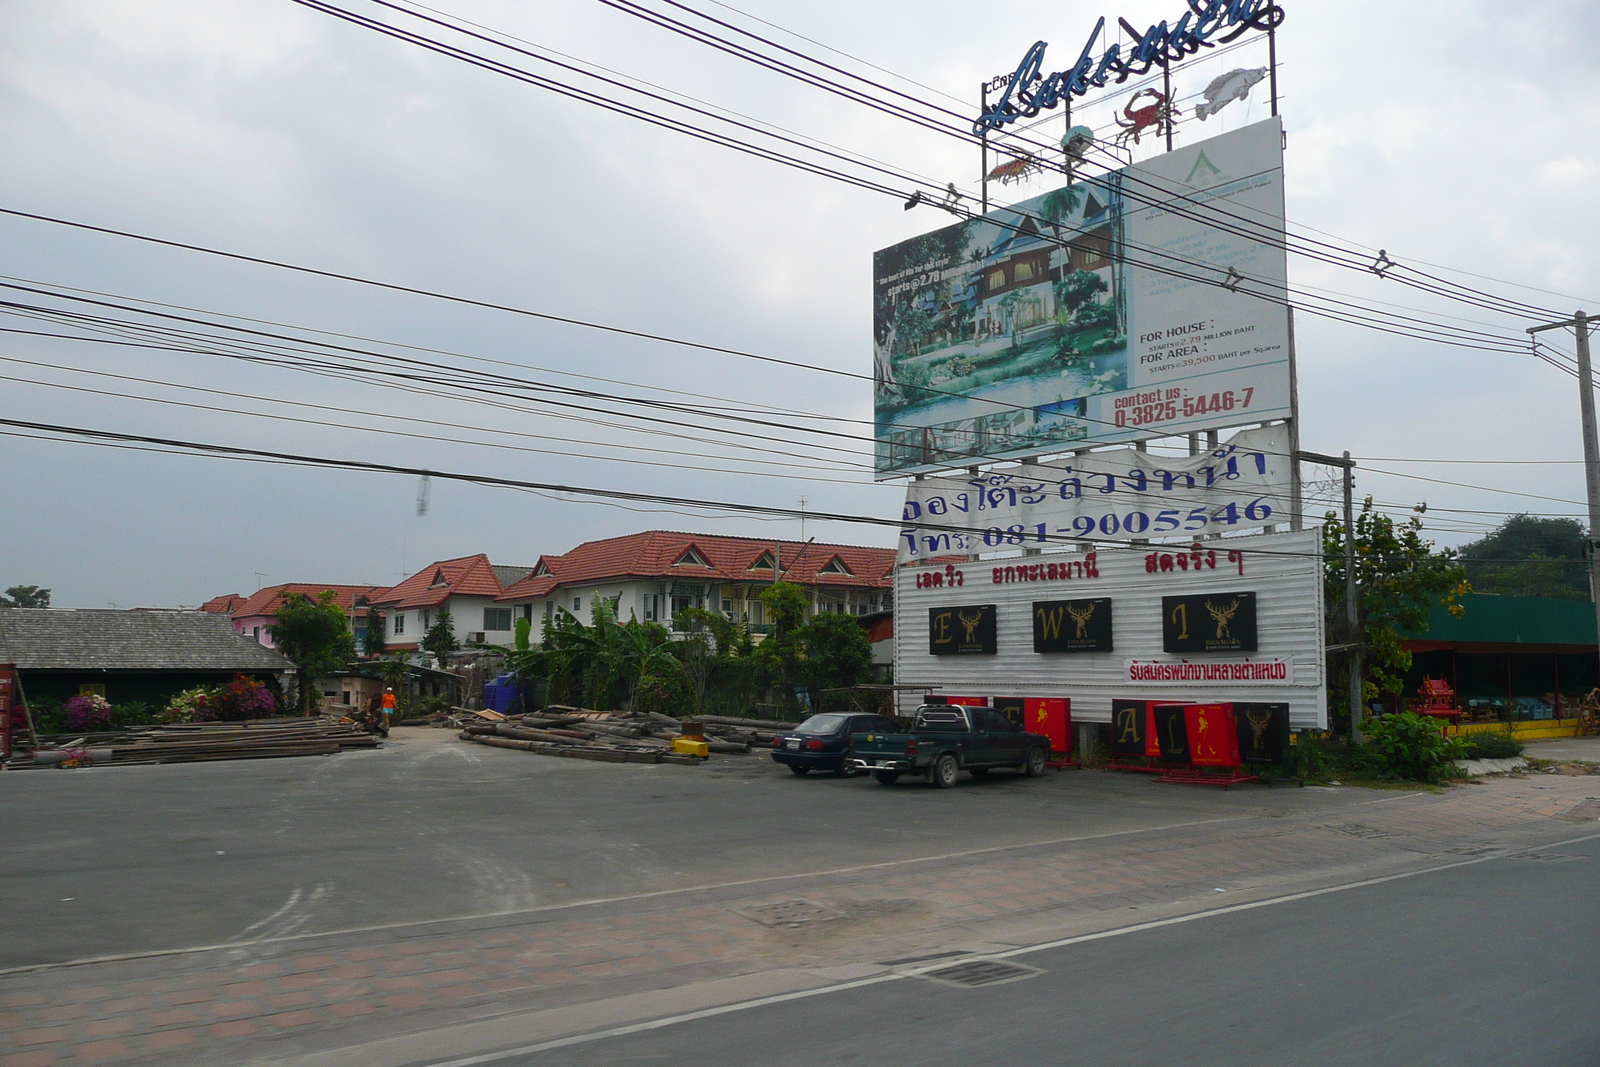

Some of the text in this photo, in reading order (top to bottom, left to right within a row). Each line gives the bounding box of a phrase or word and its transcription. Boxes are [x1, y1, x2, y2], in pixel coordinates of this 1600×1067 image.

[1140, 331, 1162, 343] FOR
[1166, 321, 1206, 338] HOUSE
[1203, 330, 1233, 341] MILLION
[1234, 325, 1256, 334] BAHT
[1140, 352, 1162, 365] FOR
[1166, 345, 1199, 360] AREA
[1217, 351, 1238, 360] BAHT
[1239, 349, 1251, 357] per
[1114, 388, 1162, 409] contact
[1166, 387, 1181, 401] us
[1114, 387, 1254, 428] 0-3825-5446-7
[982, 494, 1273, 548] 081-9005546
[934, 612, 953, 644] E
[1037, 606, 1064, 641] W
[1117, 707, 1141, 743] A
